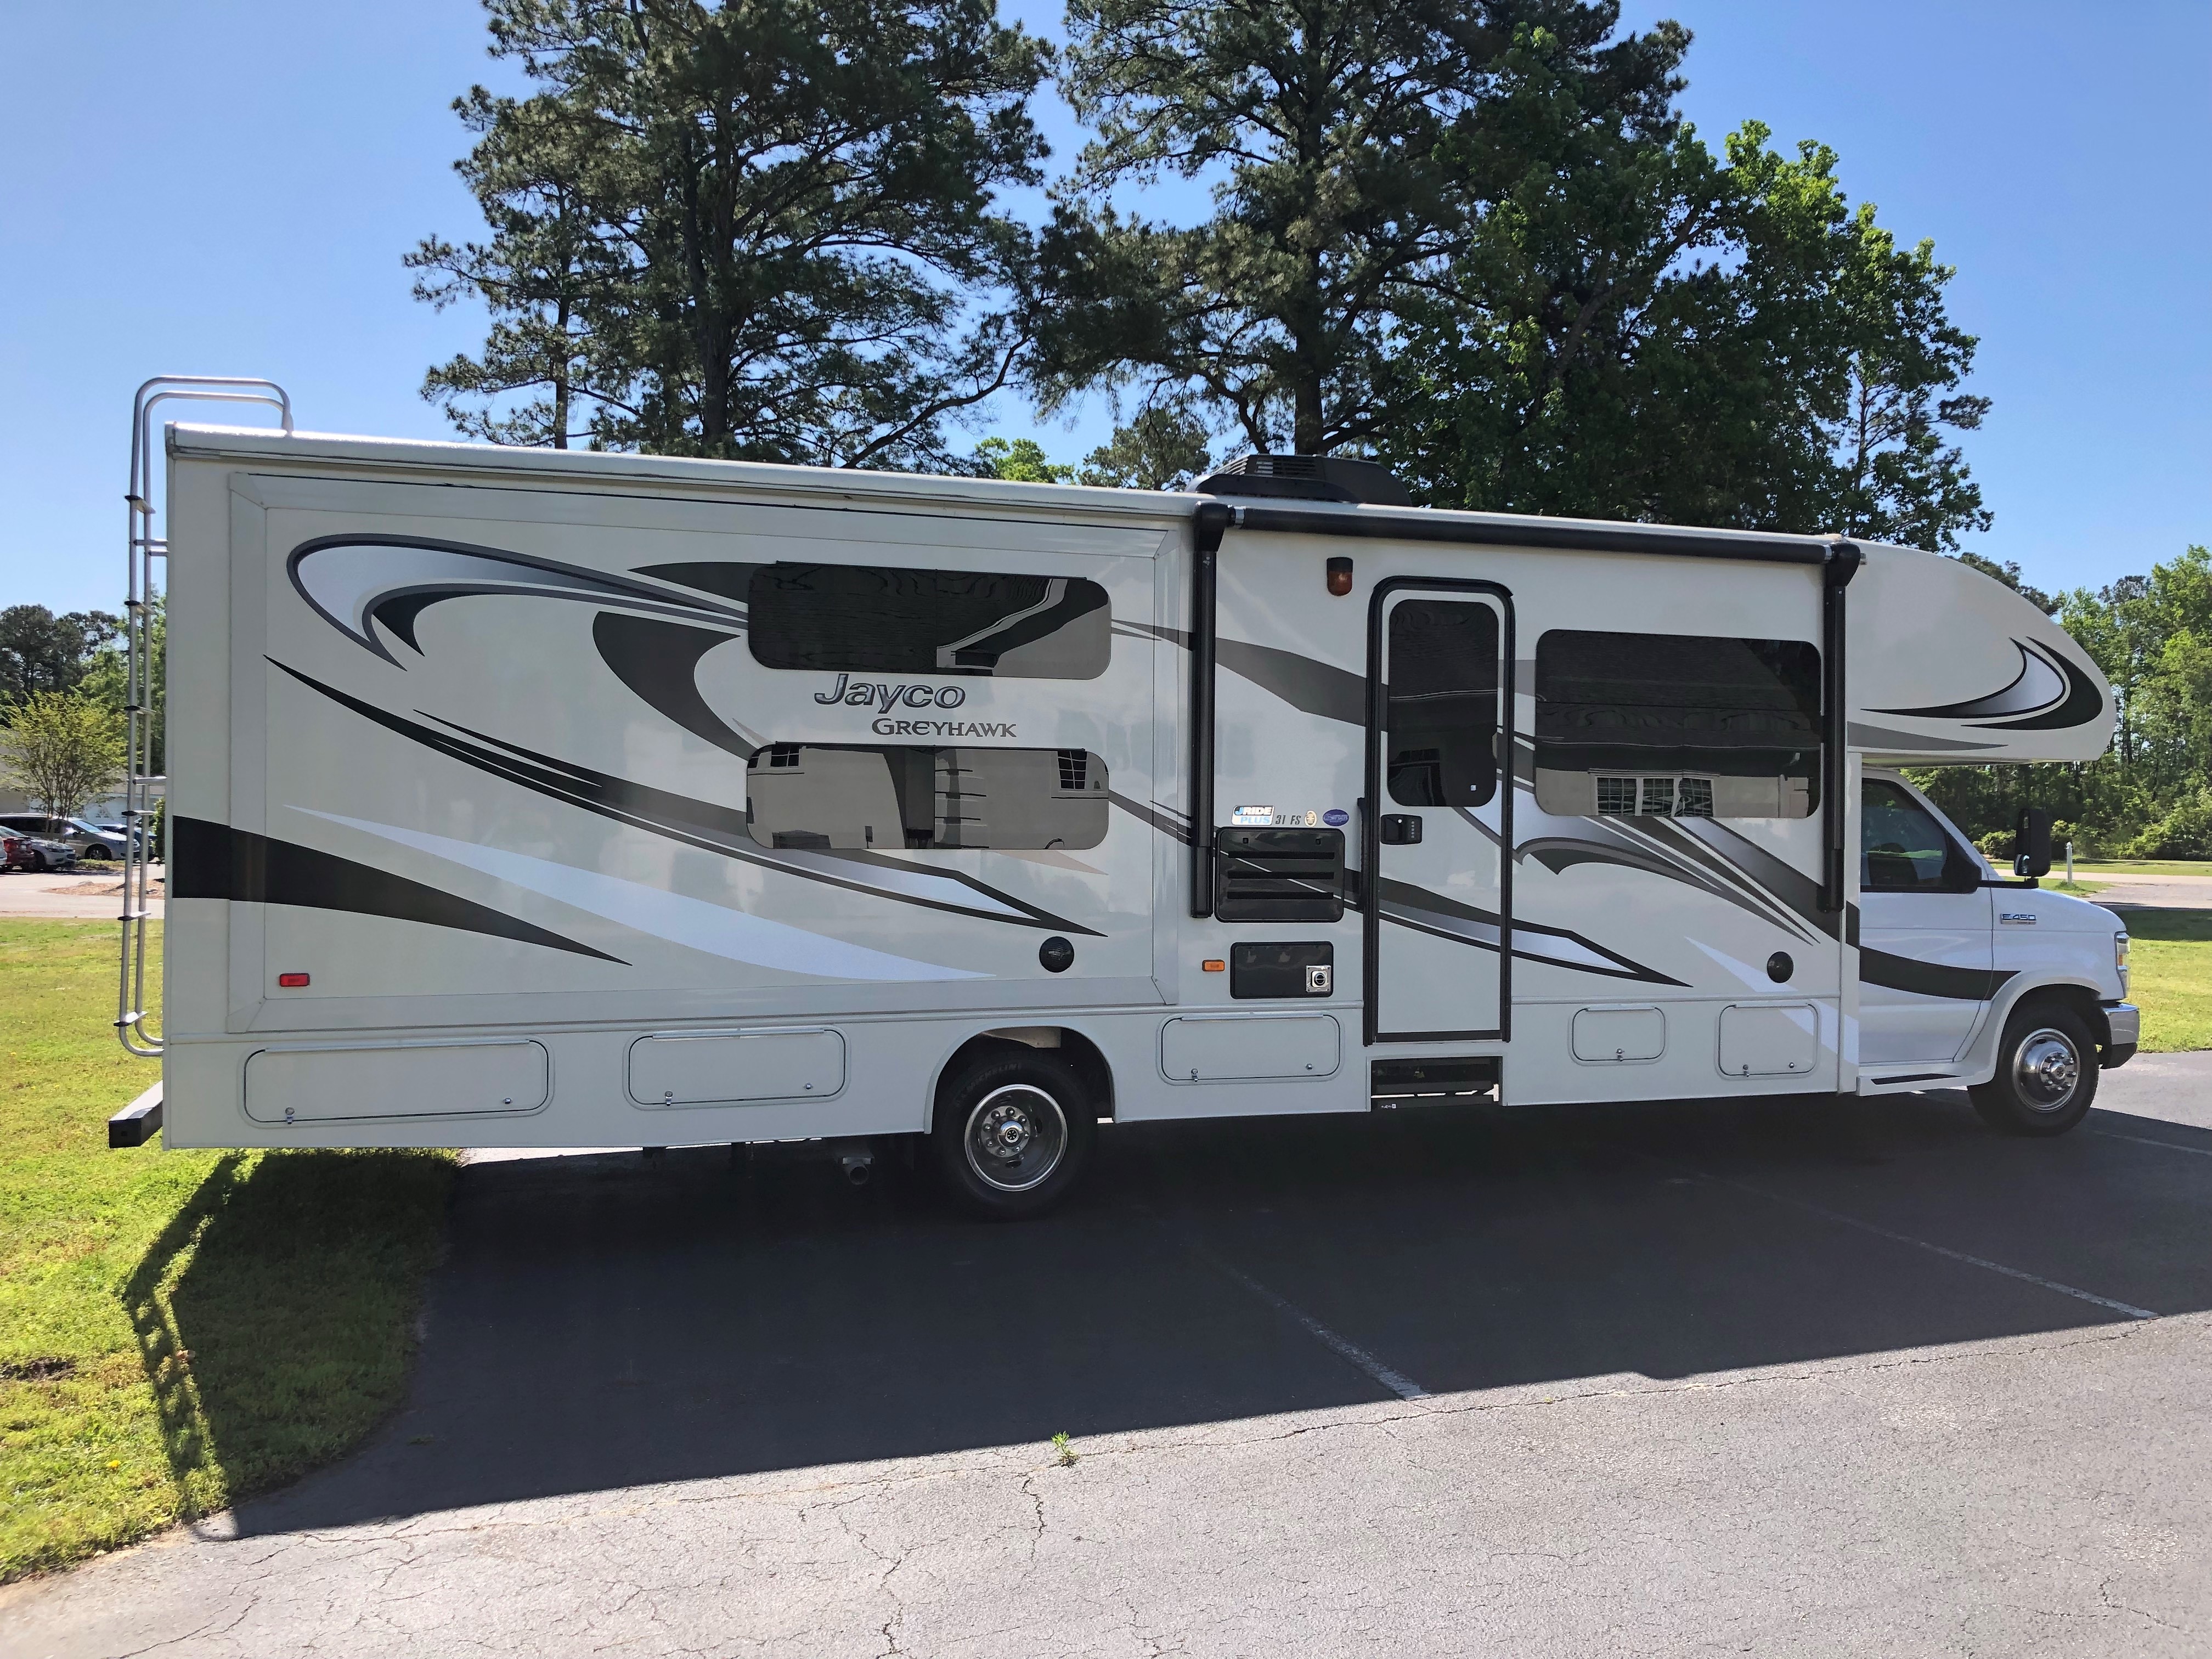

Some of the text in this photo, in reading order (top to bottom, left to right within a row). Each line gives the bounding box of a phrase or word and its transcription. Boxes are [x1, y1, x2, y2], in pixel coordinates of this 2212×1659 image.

[814, 673, 966, 714] Jayco
[872, 718, 1017, 737] GREYHAWK
[1275, 815, 1286, 825] 31
[1290, 815, 1301, 825] FS
